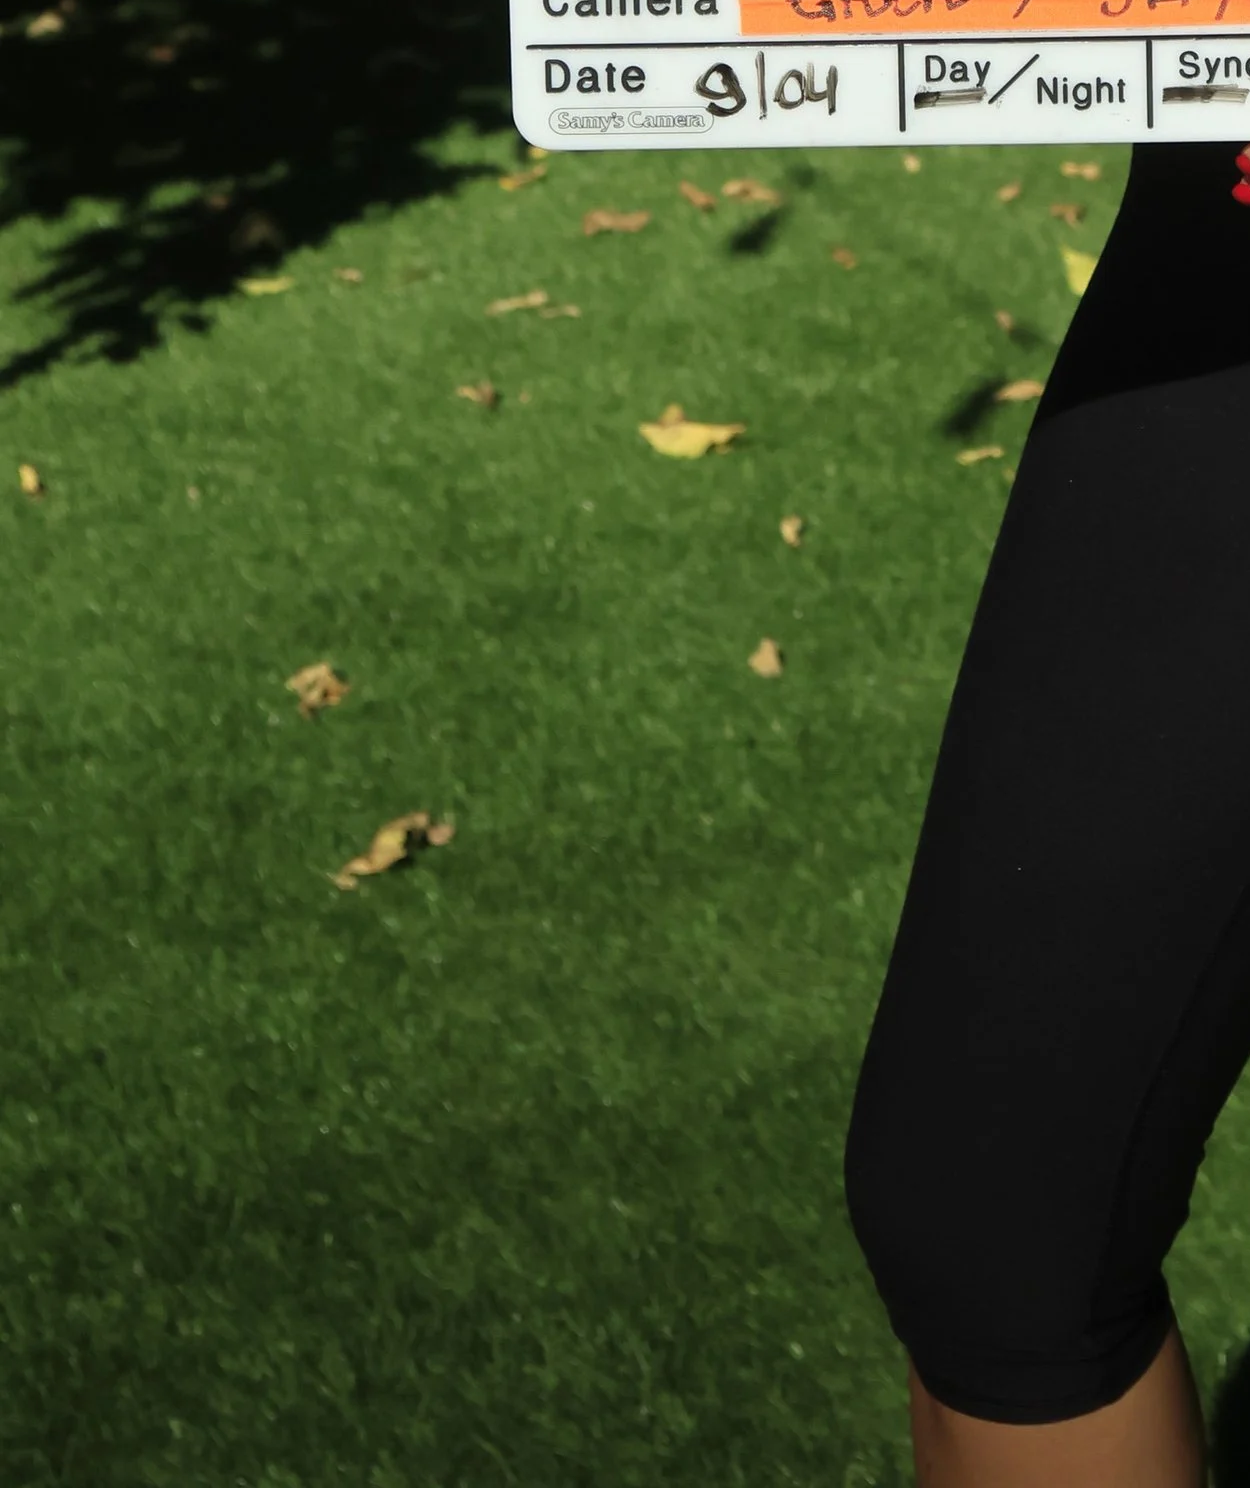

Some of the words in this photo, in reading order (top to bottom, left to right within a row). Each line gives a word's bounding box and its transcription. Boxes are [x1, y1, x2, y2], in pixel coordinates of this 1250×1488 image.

[544, 58, 647, 95] Date
[556, 110, 626, 133] Samy's
[627, 110, 707, 129] Camera
